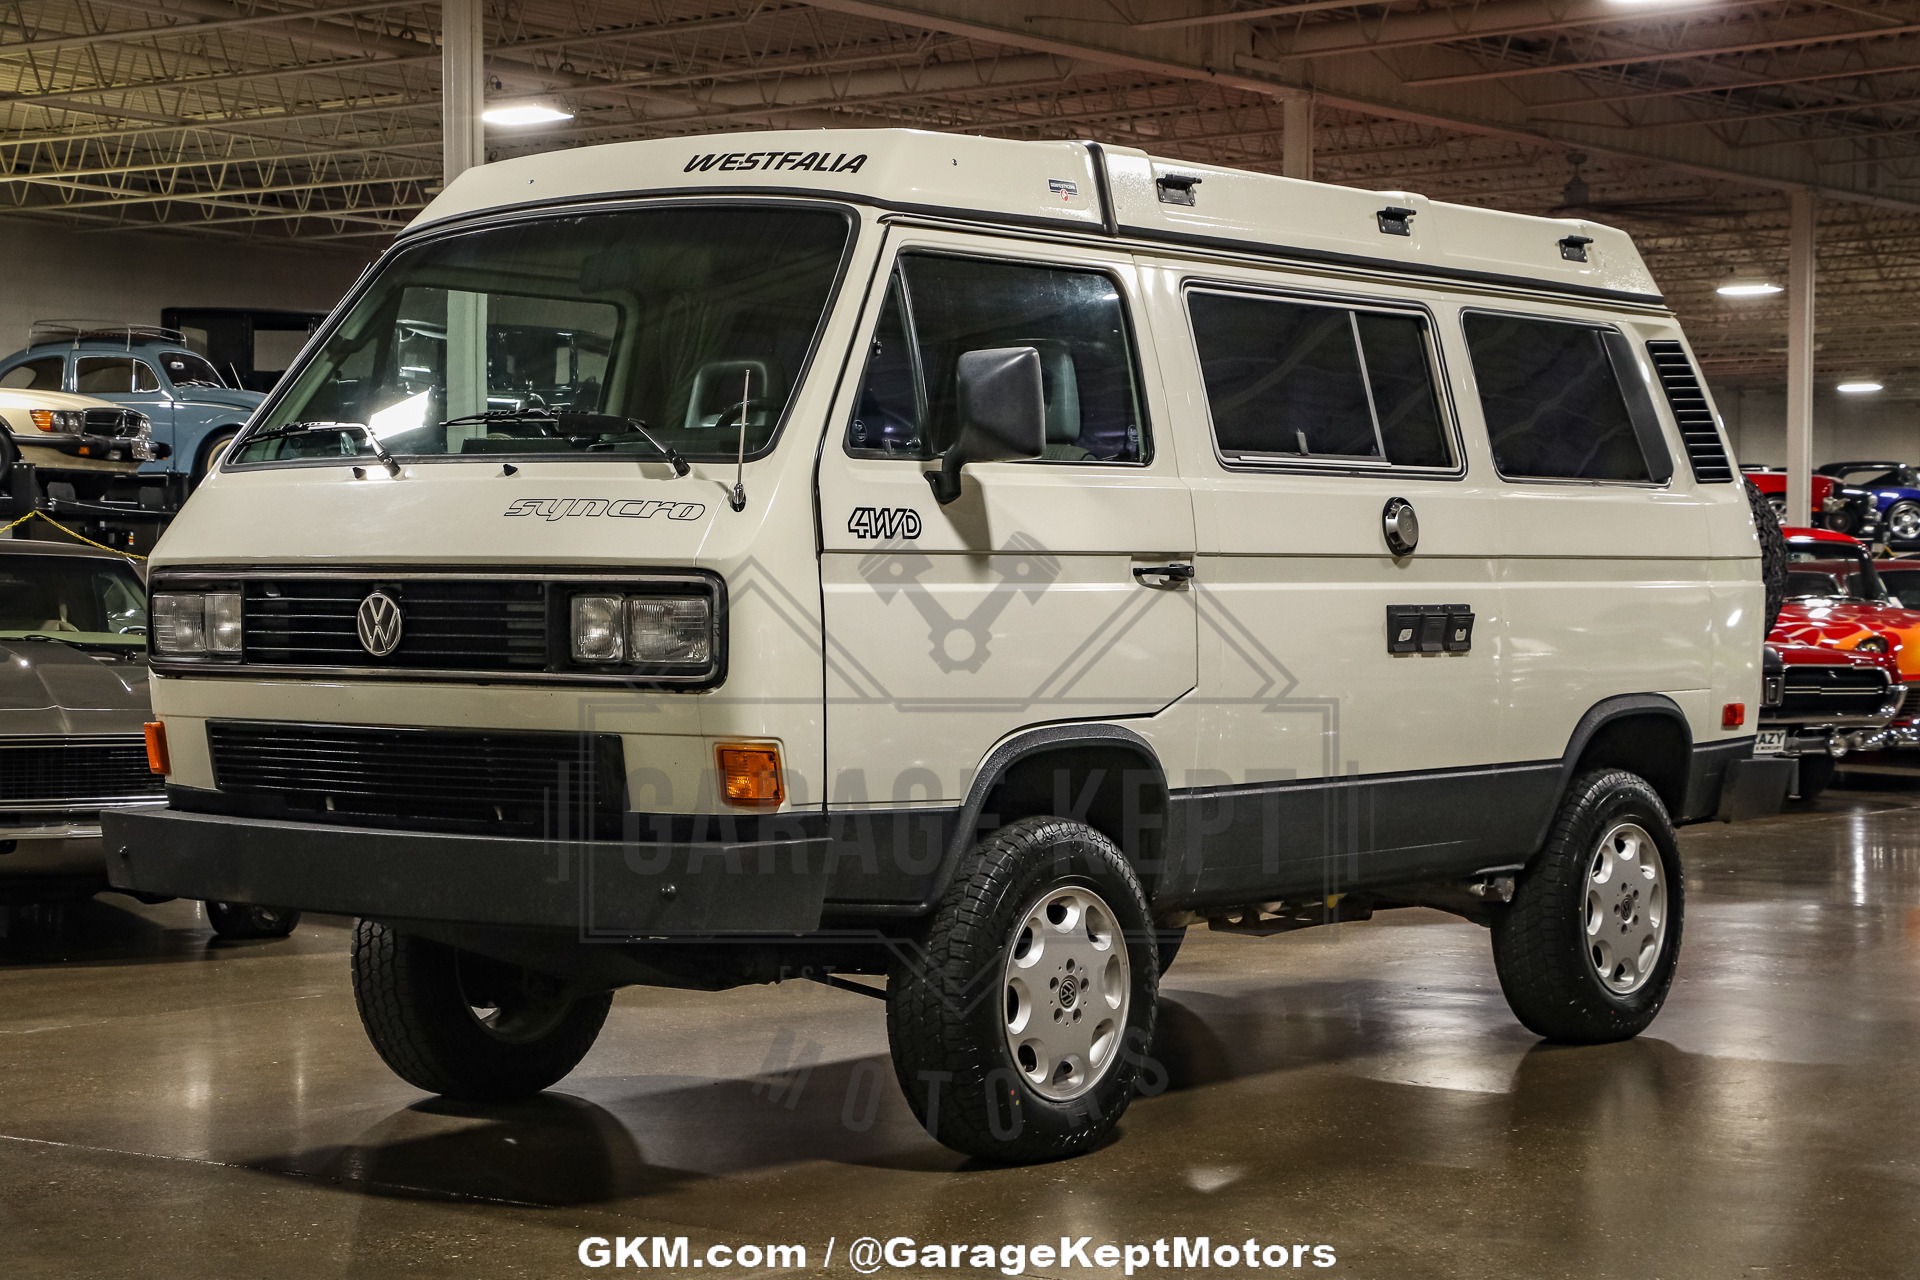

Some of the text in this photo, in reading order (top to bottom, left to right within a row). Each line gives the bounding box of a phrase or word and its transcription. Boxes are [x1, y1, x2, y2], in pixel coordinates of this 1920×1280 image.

[683, 151, 868, 174] WESTFALIA
[503, 498, 706, 522] syncro
[847, 506, 922, 540] 4WD
